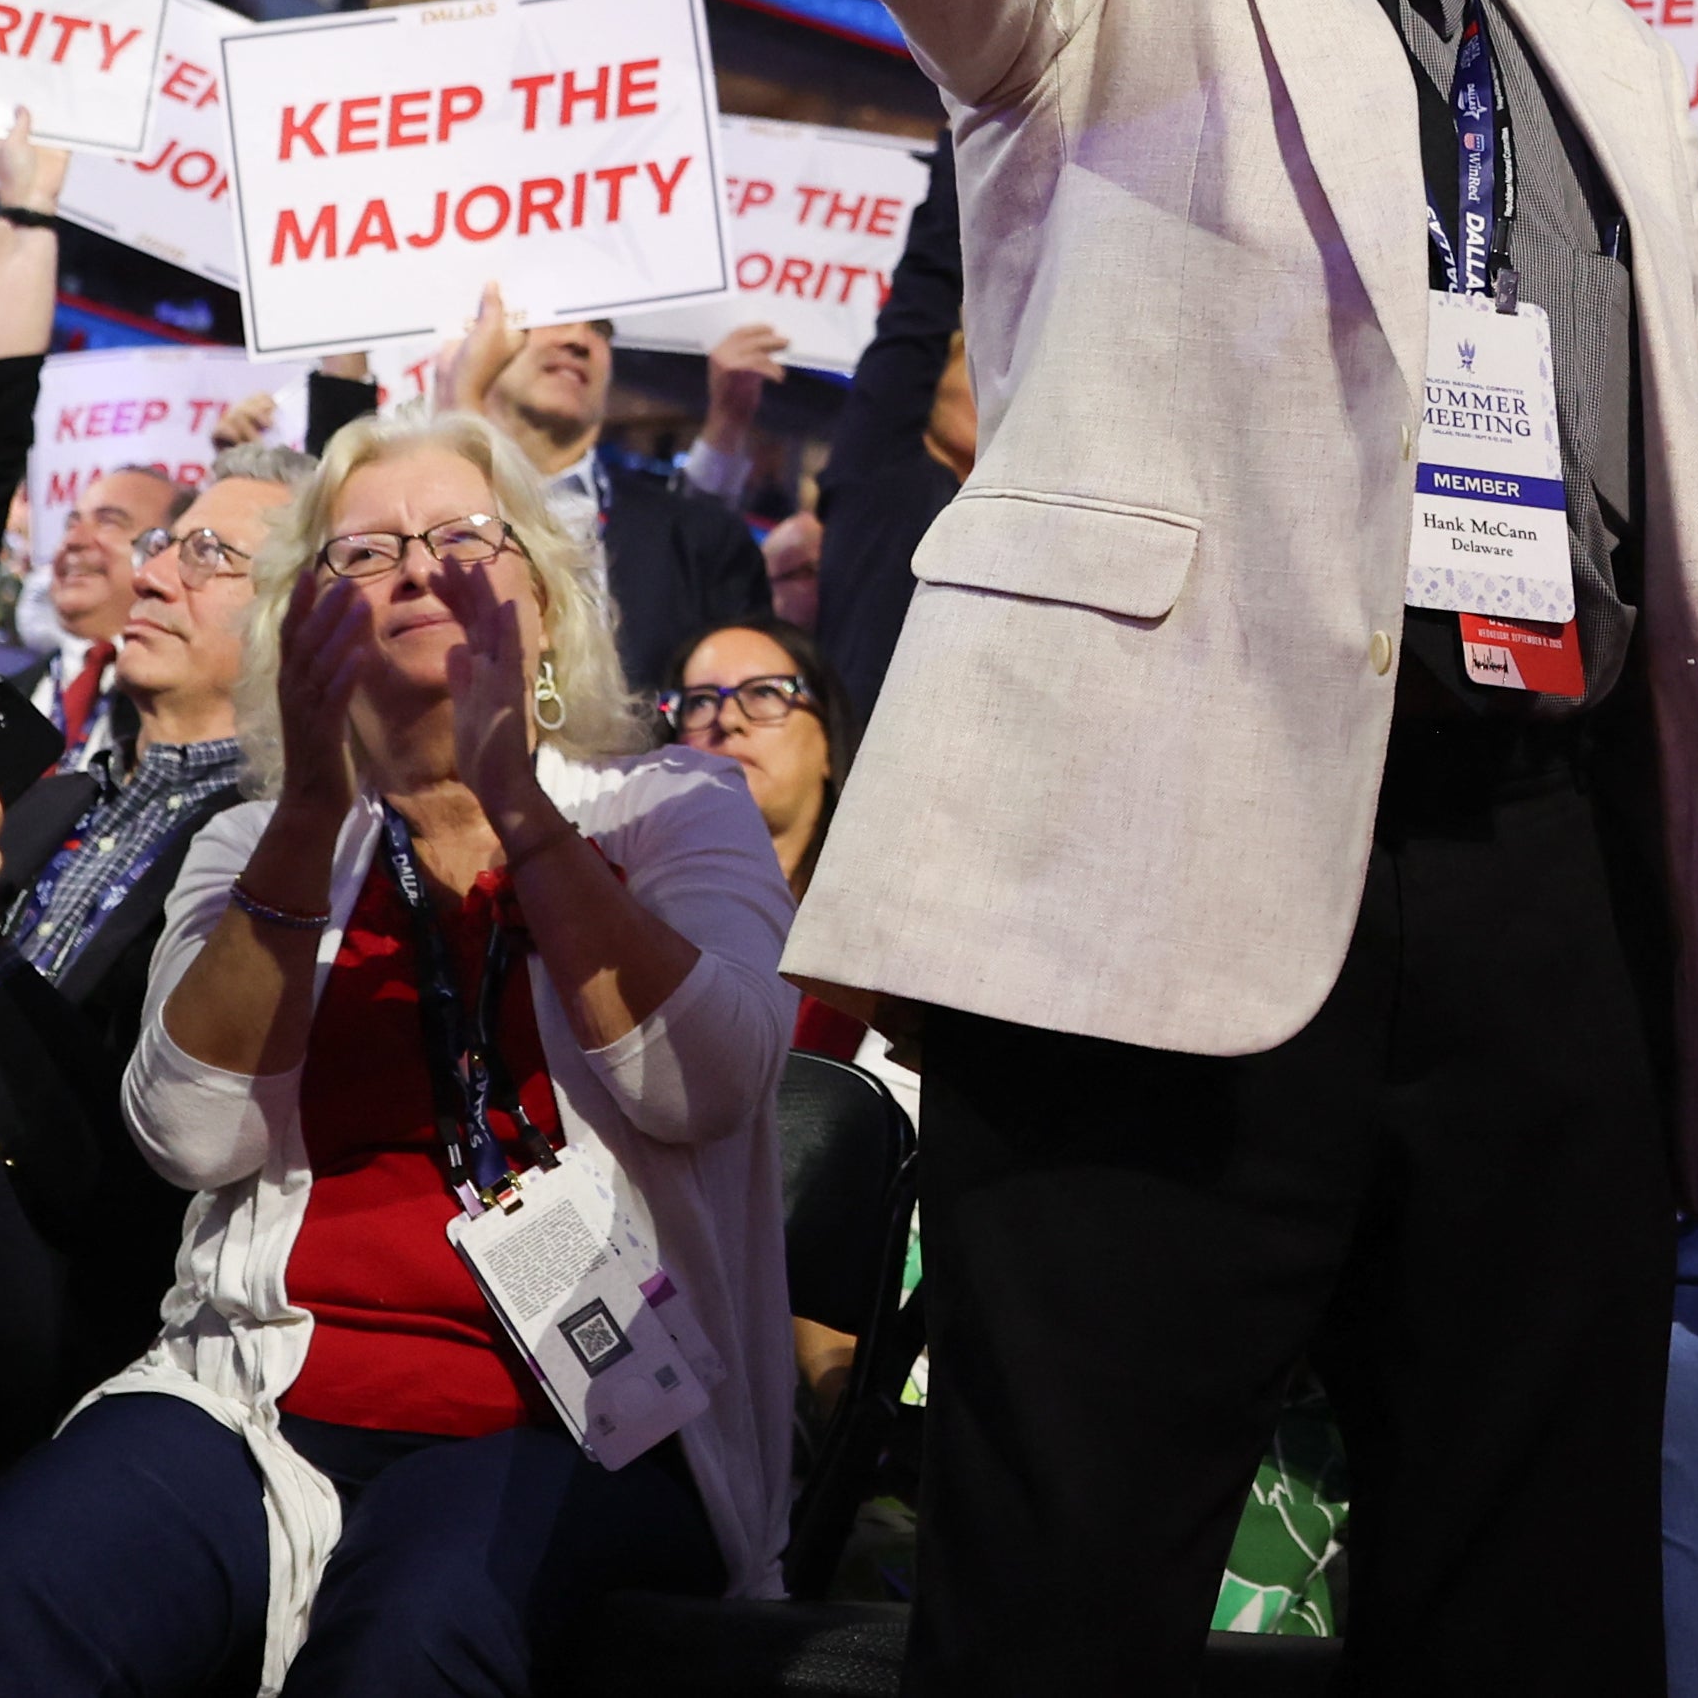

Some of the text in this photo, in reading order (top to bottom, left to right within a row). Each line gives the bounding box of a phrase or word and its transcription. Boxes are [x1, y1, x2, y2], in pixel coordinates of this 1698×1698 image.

[421, 2, 497, 26] DALLAS
[277, 83, 486, 163] KEEP
[509, 57, 662, 132] THE
[1467, 152, 1482, 201] WinRed
[269, 146, 693, 267] MAJORITY
[795, 184, 904, 239] THE
[1486, 385, 1524, 396] COMMITTEE
[56, 399, 170, 443] KEEP
[1433, 472, 1520, 498] MEMBER
[1423, 512, 1538, 542] Hank McCann
[1451, 537, 1514, 558] Delaware
